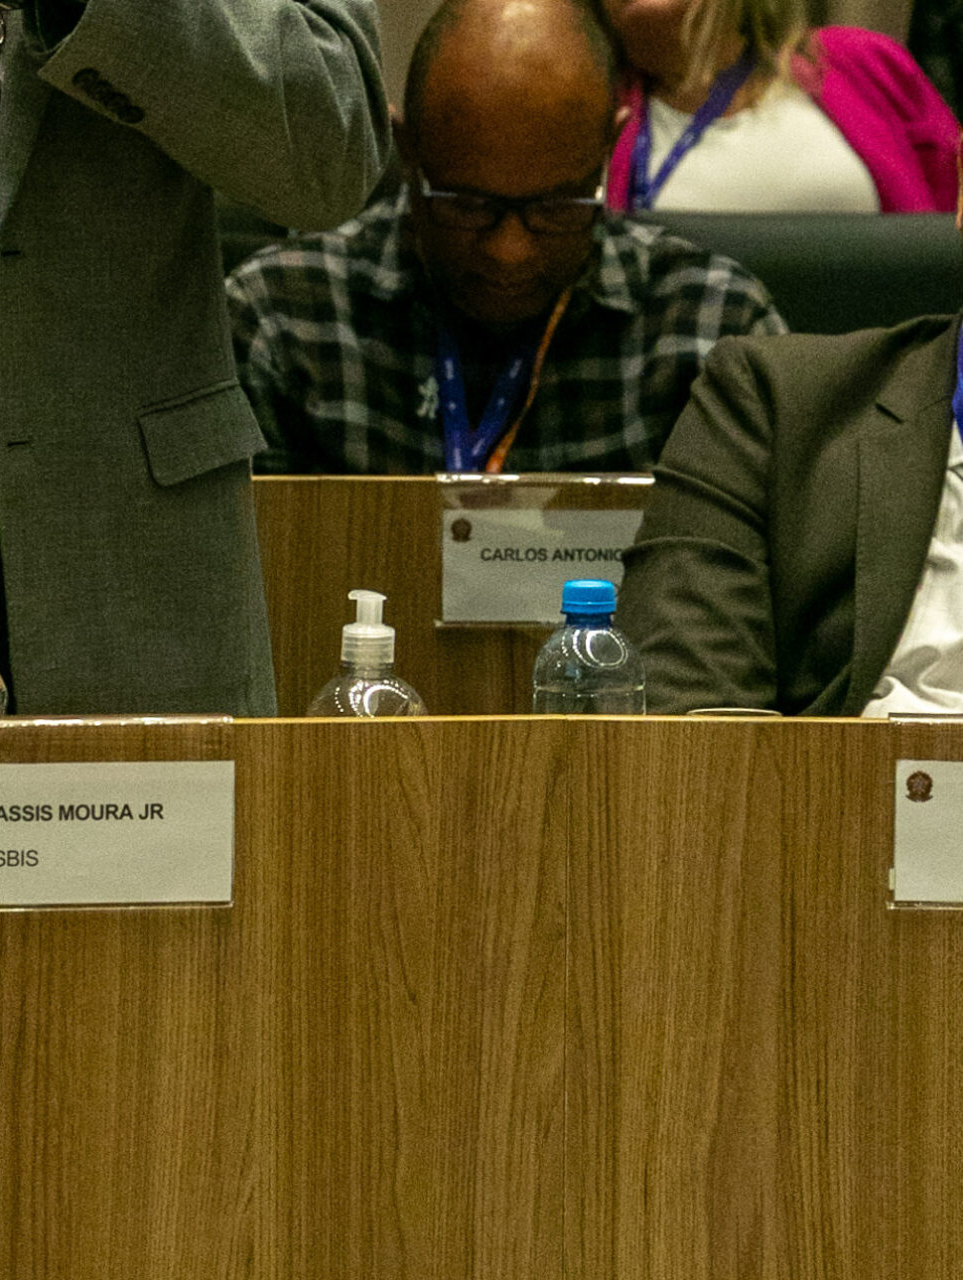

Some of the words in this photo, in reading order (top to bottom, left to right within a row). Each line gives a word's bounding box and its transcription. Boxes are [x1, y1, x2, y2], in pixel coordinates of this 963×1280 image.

[480, 547, 548, 562] CARLOS
[58, 803, 134, 821] MOURA
[138, 803, 164, 821] JR
